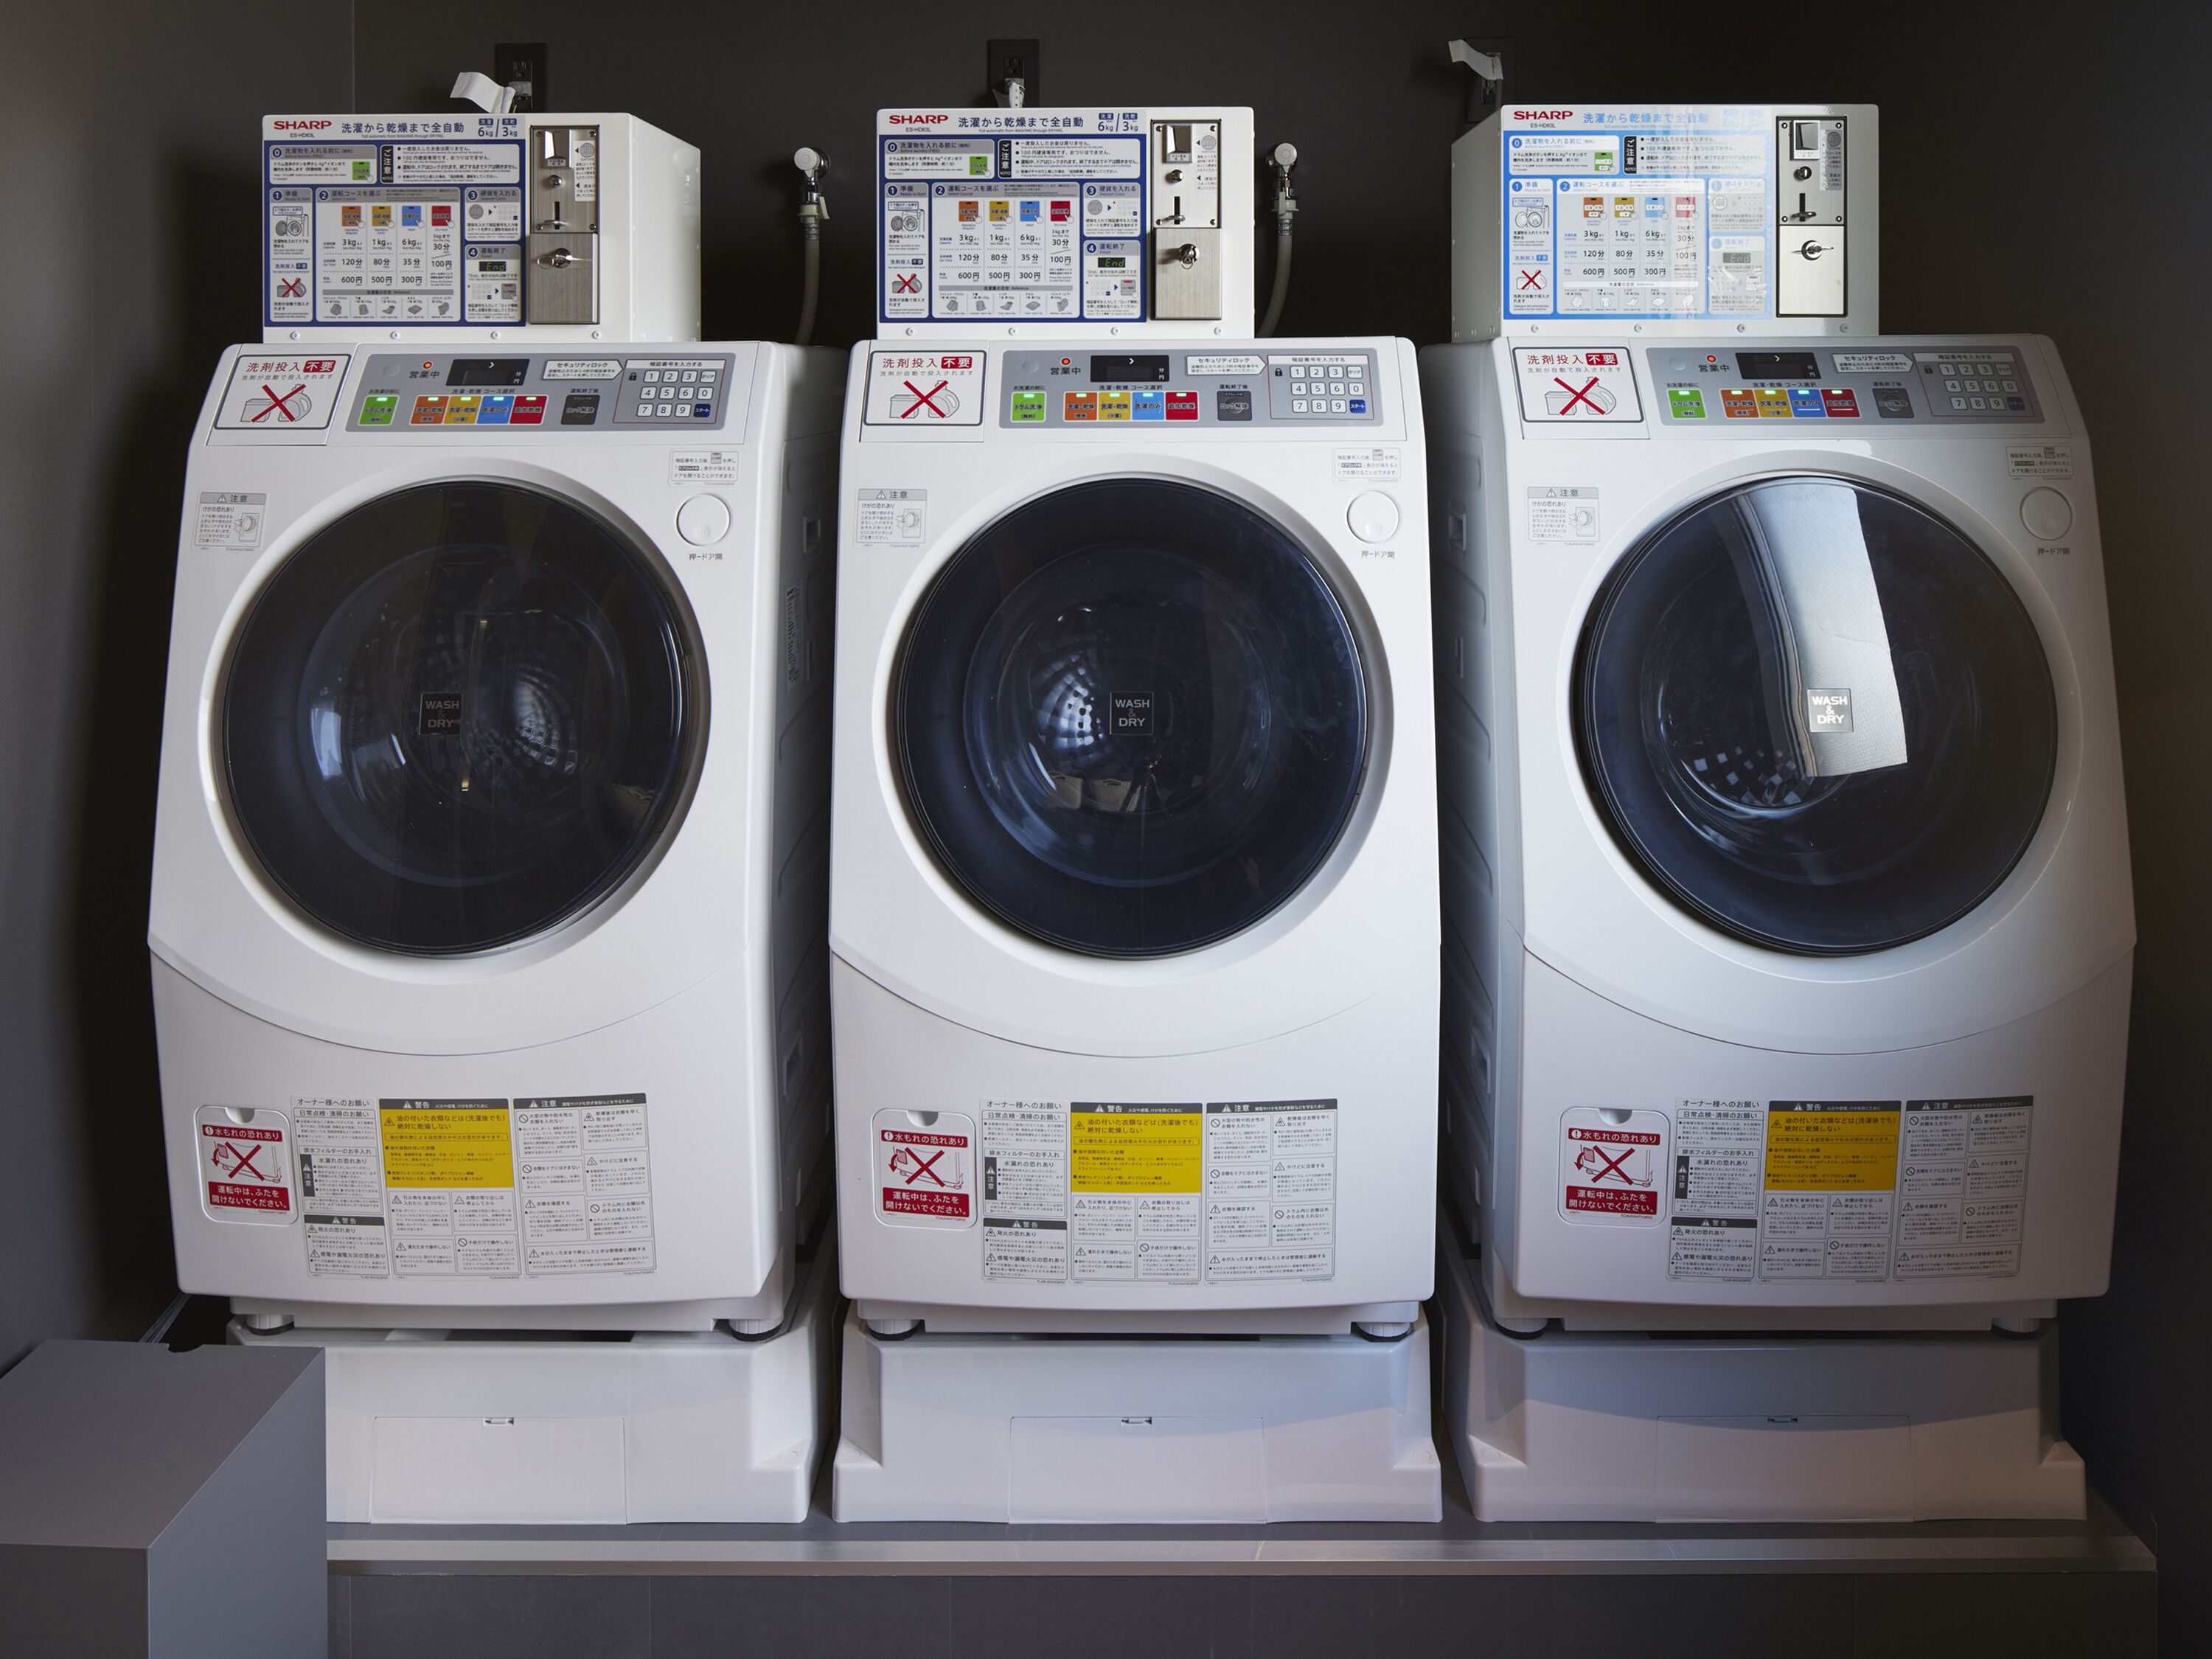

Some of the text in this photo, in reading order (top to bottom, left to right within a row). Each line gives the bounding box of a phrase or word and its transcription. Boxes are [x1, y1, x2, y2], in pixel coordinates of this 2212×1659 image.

[889, 115, 948, 124] SHARP
[1514, 111, 1573, 119] SHARP
[1583, 113, 1708, 124] 洗濯から乾燥まで全自動
[274, 121, 331, 129] SHARP
[959, 116, 1084, 128] 洗濯から乾燥まで全自動
[341, 122, 465, 133] 洗濯から乾燥まで全自動
[1001, 143, 1009, 169] ご注意
[1627, 139, 1635, 165] ご注意
[1105, 258, 1124, 267] End
[883, 358, 971, 368] 洗剤投入 不要
[1527, 355, 1616, 365] 洗剤投入 不要
[246, 361, 334, 372] 洗剤投入 不要
[1050, 367, 1081, 375] 営業中
[1698, 364, 1730, 372] 営業中
[408, 371, 440, 379] 営業中
[425, 700, 459, 709] WASH
[1115, 699, 1150, 708] WASH
[1812, 696, 1847, 706] WASH
[437, 709, 445, 718] &
[1128, 708, 1136, 717] &
[1826, 705, 1834, 715] &
[1119, 718, 1145, 726] DRY
[1817, 714, 1844, 723] DRY
[428, 720, 454, 728] DRY
[987, 1101, 1062, 1110] オーナー様へのお願い
[1683, 1099, 1759, 1109] オーナー様へのお願い
[215, 1128, 279, 1140] 水もれの恐れあり
[1583, 1131, 1657, 1143] 水もれの恐れあり
[895, 1133, 964, 1146] 水もれの恐れあり
[989, 1150, 1060, 1158] 排水フィルターのお手入れ
[1683, 1149, 1754, 1157] 排水フィルターのお手入れ
[218, 1185, 279, 1197] 運転中は、ふたを
[1577, 1189, 1647, 1202] 運転中は、ふたを
[212, 1194, 287, 1208] 開けないでください。
[893, 1191, 959, 1204] 運転中は、ふたを
[886, 1201, 966, 1215] 開けないでください。
[1569, 1199, 1654, 1213] 開けないでください。
